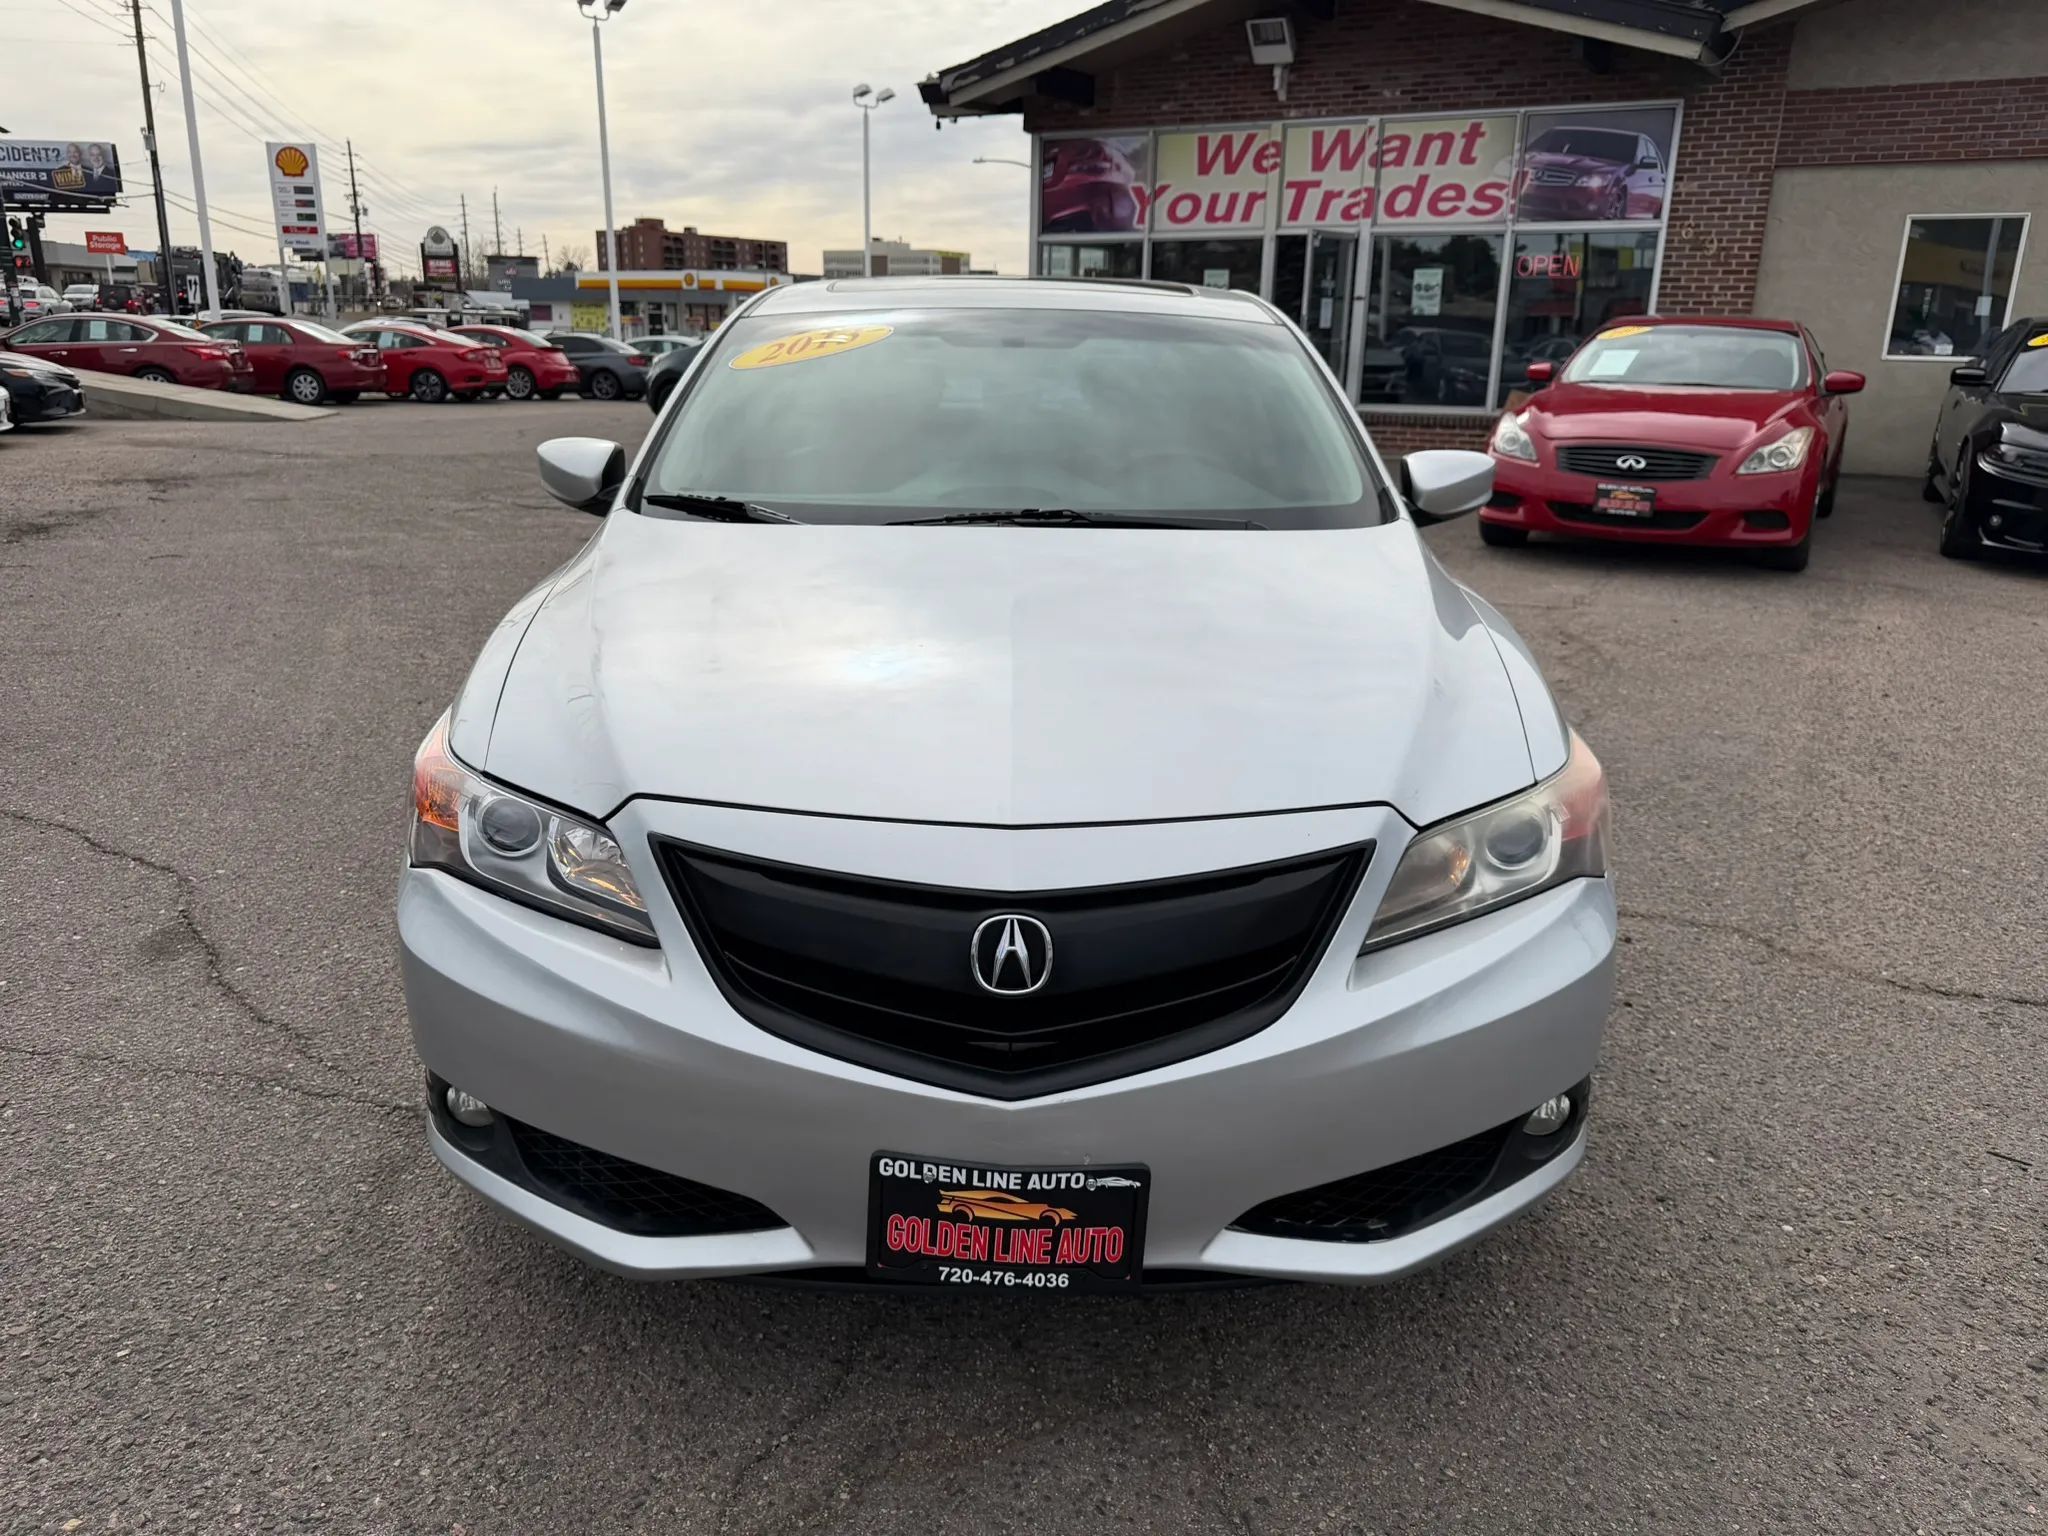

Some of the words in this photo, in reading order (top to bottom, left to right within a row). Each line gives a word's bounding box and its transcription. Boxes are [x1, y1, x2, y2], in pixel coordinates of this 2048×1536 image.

[1196, 132, 1283, 177] We
[1310, 121, 1487, 173] Want
[1129, 183, 1268, 226] Your
[1285, 171, 1529, 223] Trades!
[90, 241, 122, 250] Storage
[92, 234, 118, 242] Public
[1517, 255, 1581, 278] OPEN
[878, 1157, 967, 1185] GOLDEN
[972, 1169, 1022, 1189] LINE
[1027, 1172, 1085, 1190] AUTO
[886, 1214, 989, 1262] GOLDEN
[994, 1227, 1052, 1265] LINE
[1056, 1226, 1125, 1264] AUTO
[938, 1266, 1069, 1288] 720-476-4036
